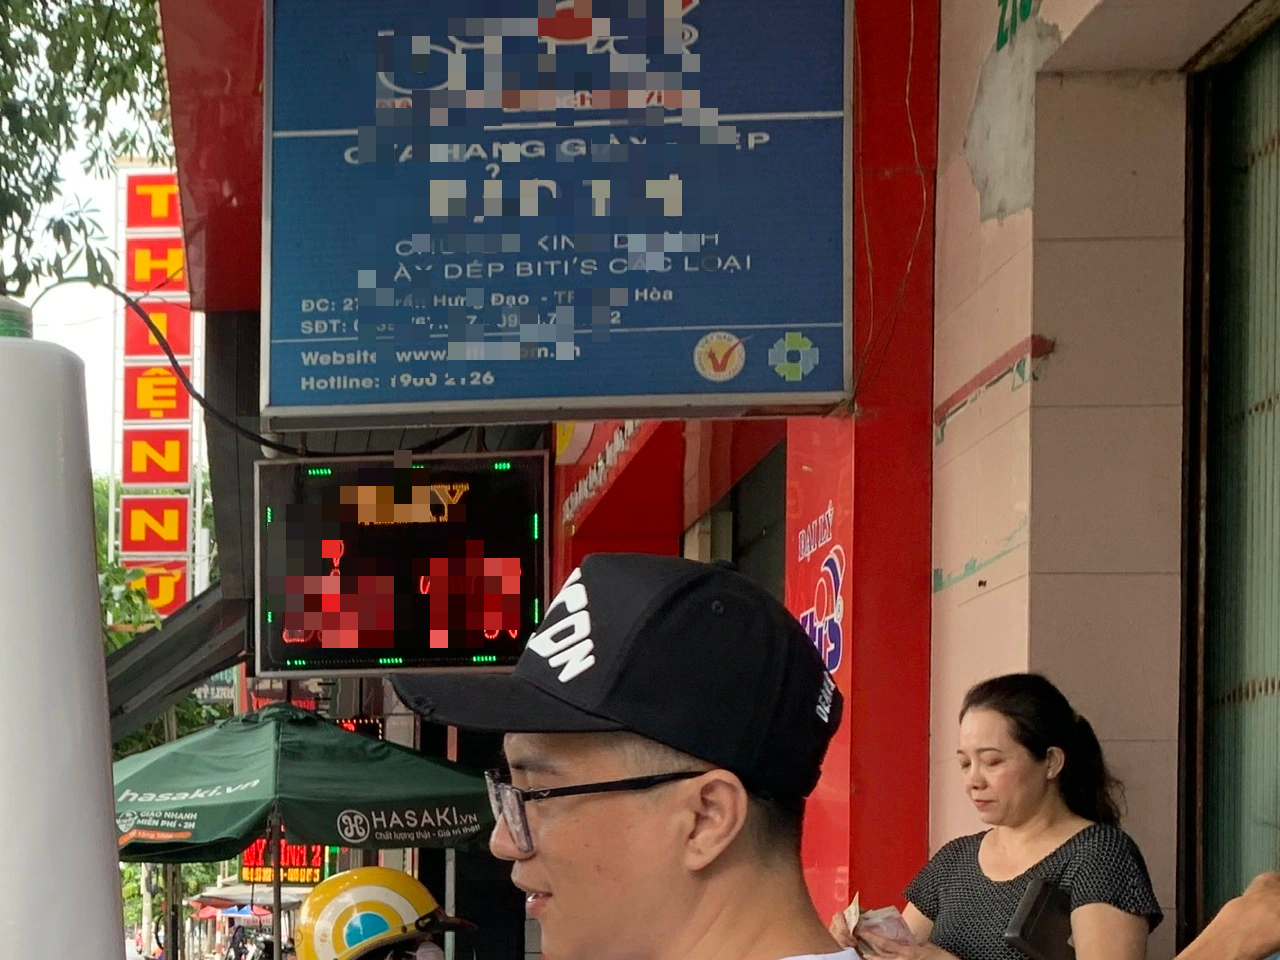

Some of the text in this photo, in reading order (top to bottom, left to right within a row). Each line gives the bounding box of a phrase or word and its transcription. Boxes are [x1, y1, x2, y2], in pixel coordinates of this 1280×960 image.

[444, 259, 505, 279] DÉP
[491, 292, 530, 308] Đạo
[635, 287, 673, 302] Hòa
[300, 375, 380, 391] Hotline:
[117, 779, 261, 802] hasaki.vn
[371, 806, 478, 829] HASAKI.VN
